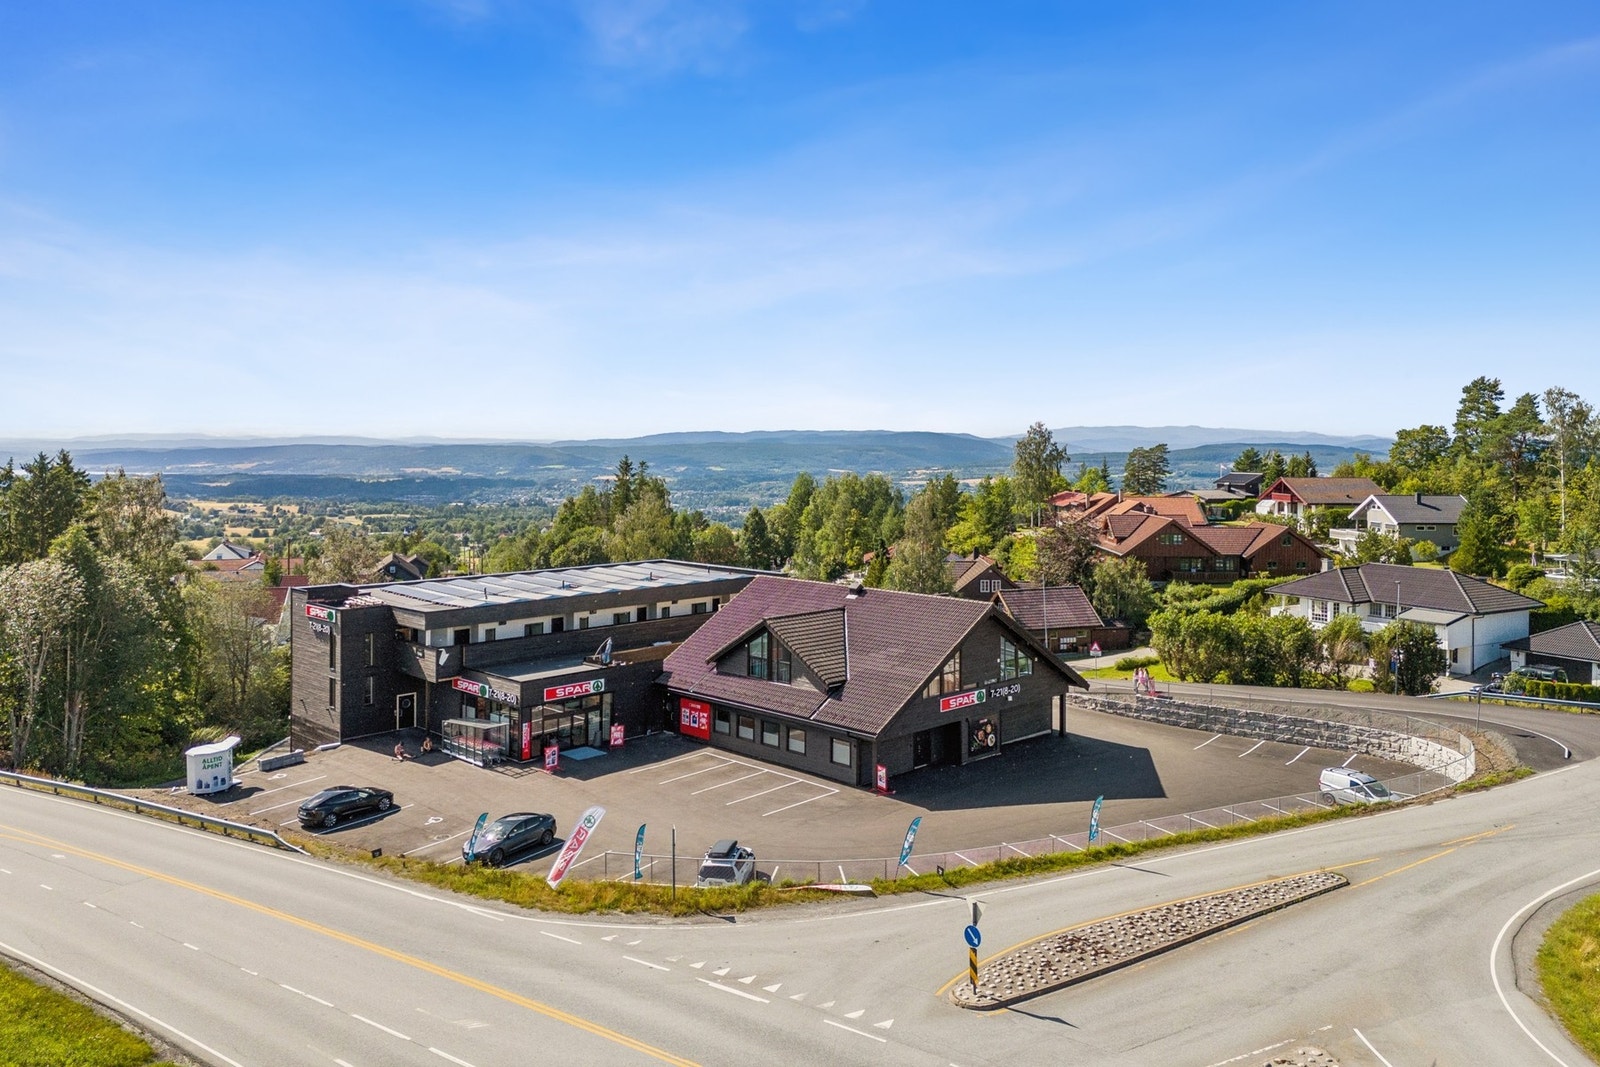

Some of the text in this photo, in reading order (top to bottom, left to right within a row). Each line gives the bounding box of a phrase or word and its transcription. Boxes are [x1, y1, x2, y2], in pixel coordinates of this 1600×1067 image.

[310, 607, 328, 619] SPAR
[457, 681, 480, 694] SPAR
[556, 684, 591, 697] SPAR
[949, 694, 976, 708] SPAR
[202, 756, 222, 764] ALLTID
[202, 762, 222, 770] ÅPENT
